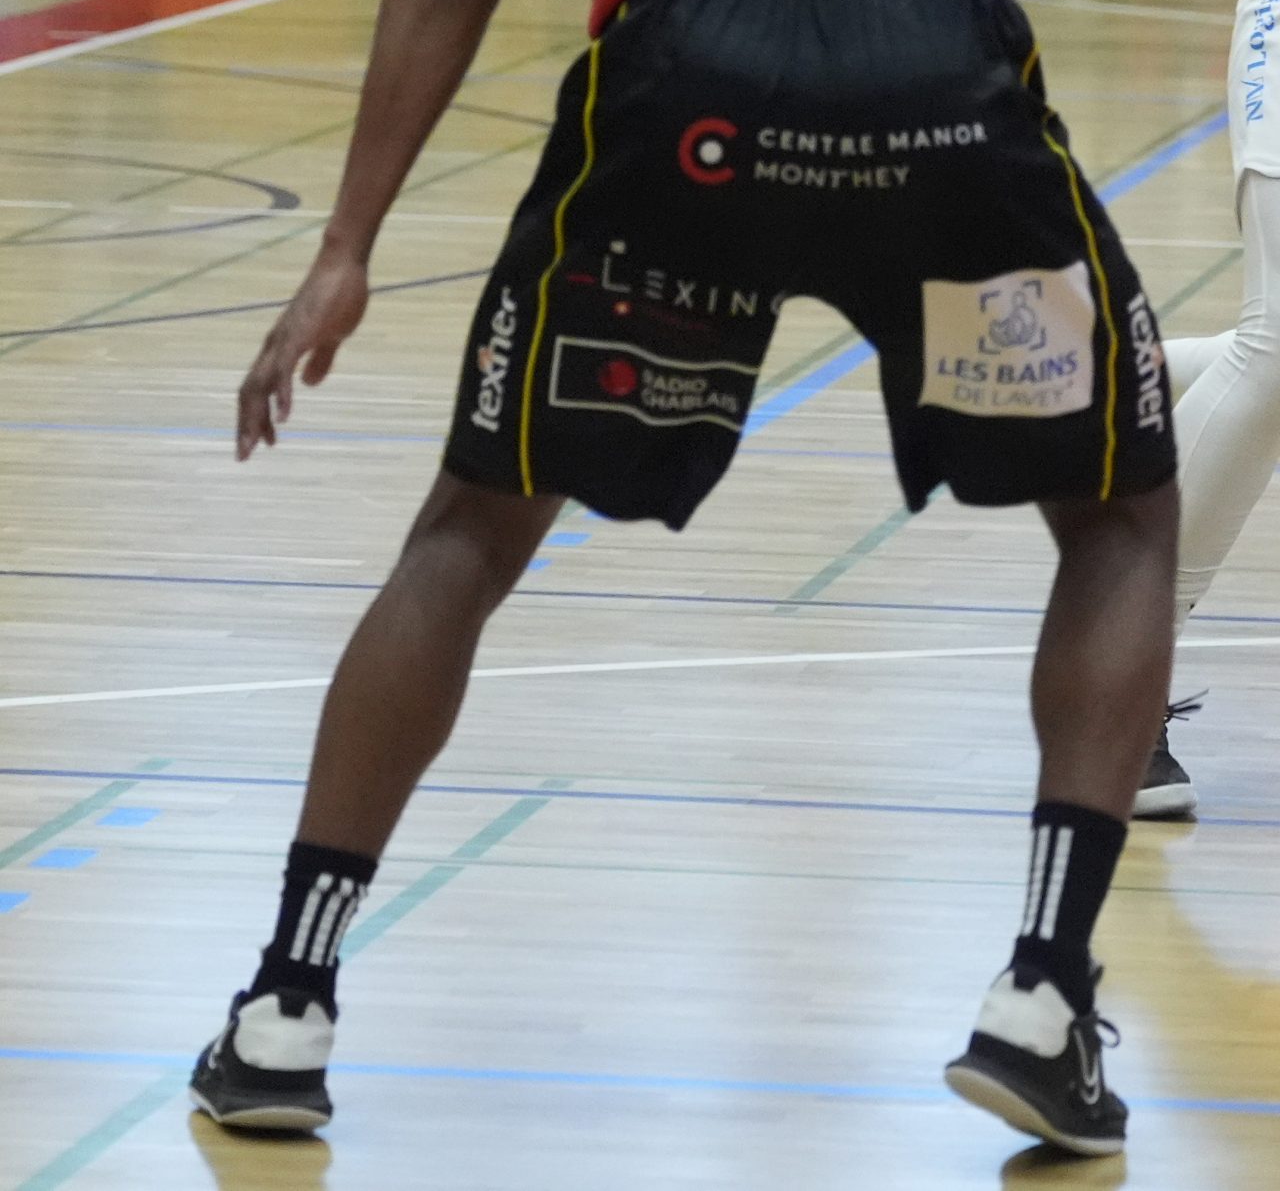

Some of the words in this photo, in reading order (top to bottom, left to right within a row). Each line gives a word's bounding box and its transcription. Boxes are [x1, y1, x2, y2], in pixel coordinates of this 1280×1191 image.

[757, 126, 875, 157] CENTRE
[888, 121, 988, 152] MANOR
[753, 160, 912, 190] MONTHEY
[937, 356, 989, 383] LES
[996, 350, 1078, 385] BAINS
